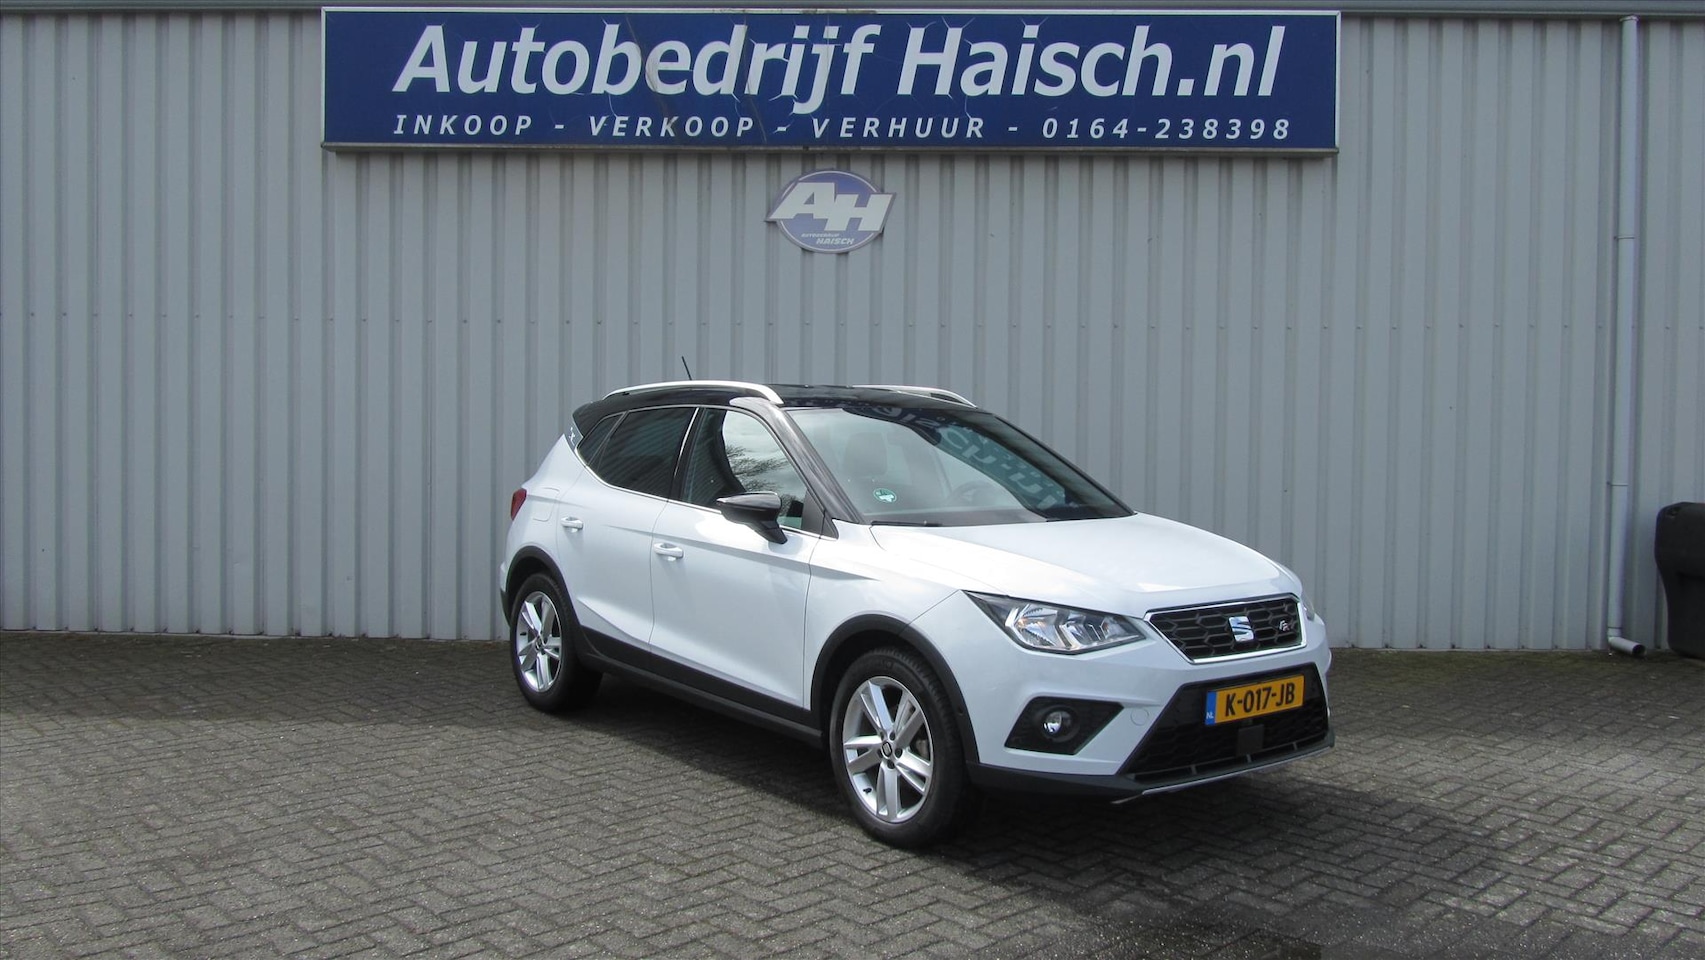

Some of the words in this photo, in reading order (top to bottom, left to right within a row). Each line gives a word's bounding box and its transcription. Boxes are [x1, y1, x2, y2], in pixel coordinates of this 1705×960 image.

[392, 24, 882, 115] Autobedrijf
[897, 24, 1286, 98] Haisch.nl
[393, 114, 533, 136] INKOOP
[589, 115, 754, 138] VERKOOP
[812, 117, 985, 139] VERHUUR
[1042, 117, 1290, 141] 0164-238398
[768, 181, 894, 232] AH
[816, 237, 855, 245] HAISCH
[1206, 711, 1215, 719] NL
[1225, 682, 1296, 717] K-017-JB
